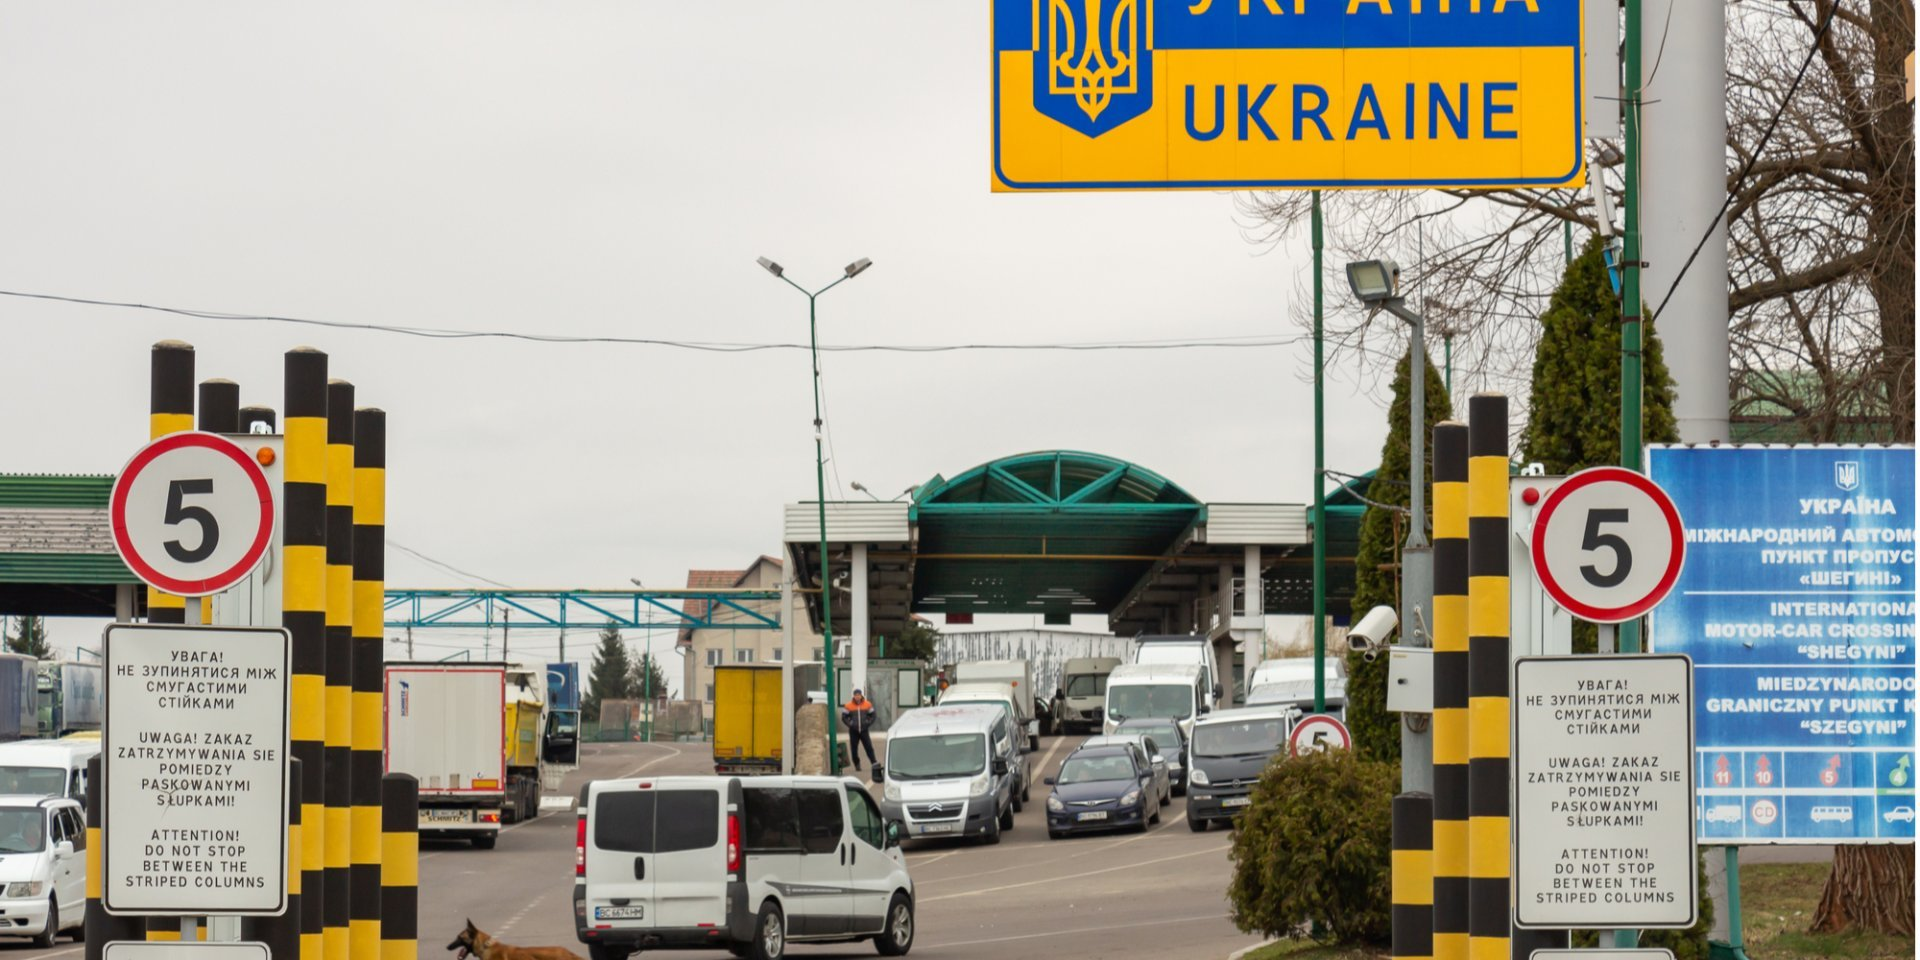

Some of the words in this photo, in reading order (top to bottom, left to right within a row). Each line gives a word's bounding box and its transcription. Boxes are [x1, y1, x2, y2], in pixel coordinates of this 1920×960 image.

[1185, 82, 1518, 141] UKRAINE
[1800, 495, 1897, 515] УКРАЇНА
[164, 479, 220, 563] 5
[1685, 525, 1836, 545] МІЖНАРОДНИЙ
[1841, 528, 1915, 543] АВТОМ
[1580, 509, 1633, 587] 5
[1761, 550, 1828, 564] ПУНКТ
[1800, 571, 1902, 585] «ШЕГИНІ»
[1704, 624, 1823, 638] MOTOR-CAR
[171, 651, 223, 663] УВАГА!
[117, 665, 134, 676] НЕ
[142, 666, 239, 679] ЗУПИНЯТИСЯ
[246, 667, 277, 679] МІЖ
[146, 681, 247, 694] СМУГАСТИМИ
[1577, 679, 1628, 691] УВАГА!
[158, 694, 234, 709] СТІЙКАМИ
[1526, 695, 1543, 706] НЕ
[1551, 694, 1644, 706] ЗУПИНЯТИСЯ
[1650, 693, 1680, 705] МІЖ
[1706, 698, 1826, 712] GRANICZNY
[1829, 699, 1899, 713] PUNKT
[1554, 708, 1652, 721] СМУГАСТИМИ
[1566, 722, 1640, 735] СТІЙКАМИ
[139, 732, 197, 744] UWAGA!
[204, 733, 252, 745] ZAKAZ
[118, 747, 246, 761] ZATRZYMYWANIA
[253, 750, 274, 761] SIE
[1548, 757, 1605, 769] UWAGA!
[1612, 756, 1659, 768] ZAKAZ
[1528, 771, 1653, 784] ZATRZYMYWANIA
[1660, 771, 1681, 782] SIE
[1716, 771, 1729, 783] 11
[1756, 771, 1771, 783] 10
[1824, 771, 1834, 783] 5
[1892, 771, 1904, 783] 4
[141, 779, 250, 791] PASKOWANYMI
[157, 795, 235, 807] SŁUPKAMI!
[1551, 800, 1658, 812] PASKOWANYMI
[1754, 806, 1775, 818] CD
[1567, 815, 1643, 827] SŁUPKAMI!
[151, 829, 239, 842] ATTENTION!
[145, 845, 164, 856] DO
[172, 845, 201, 857] NOT
[208, 845, 246, 857] STOP
[1561, 848, 1648, 860] ATTENTION!
[143, 861, 213, 872] BETWEEN
[220, 861, 247, 873] THE
[1555, 863, 1574, 874] DO
[1581, 863, 1610, 874] NOT
[1618, 862, 1655, 874] STOP
[126, 876, 187, 888] STRIPED
[194, 876, 265, 888] COLUMNS
[1553, 877, 1622, 889] BETWEEN
[1630, 877, 1657, 889] THE
[1536, 892, 1597, 904] STRIPED
[1604, 892, 1675, 903] COLUMNS
